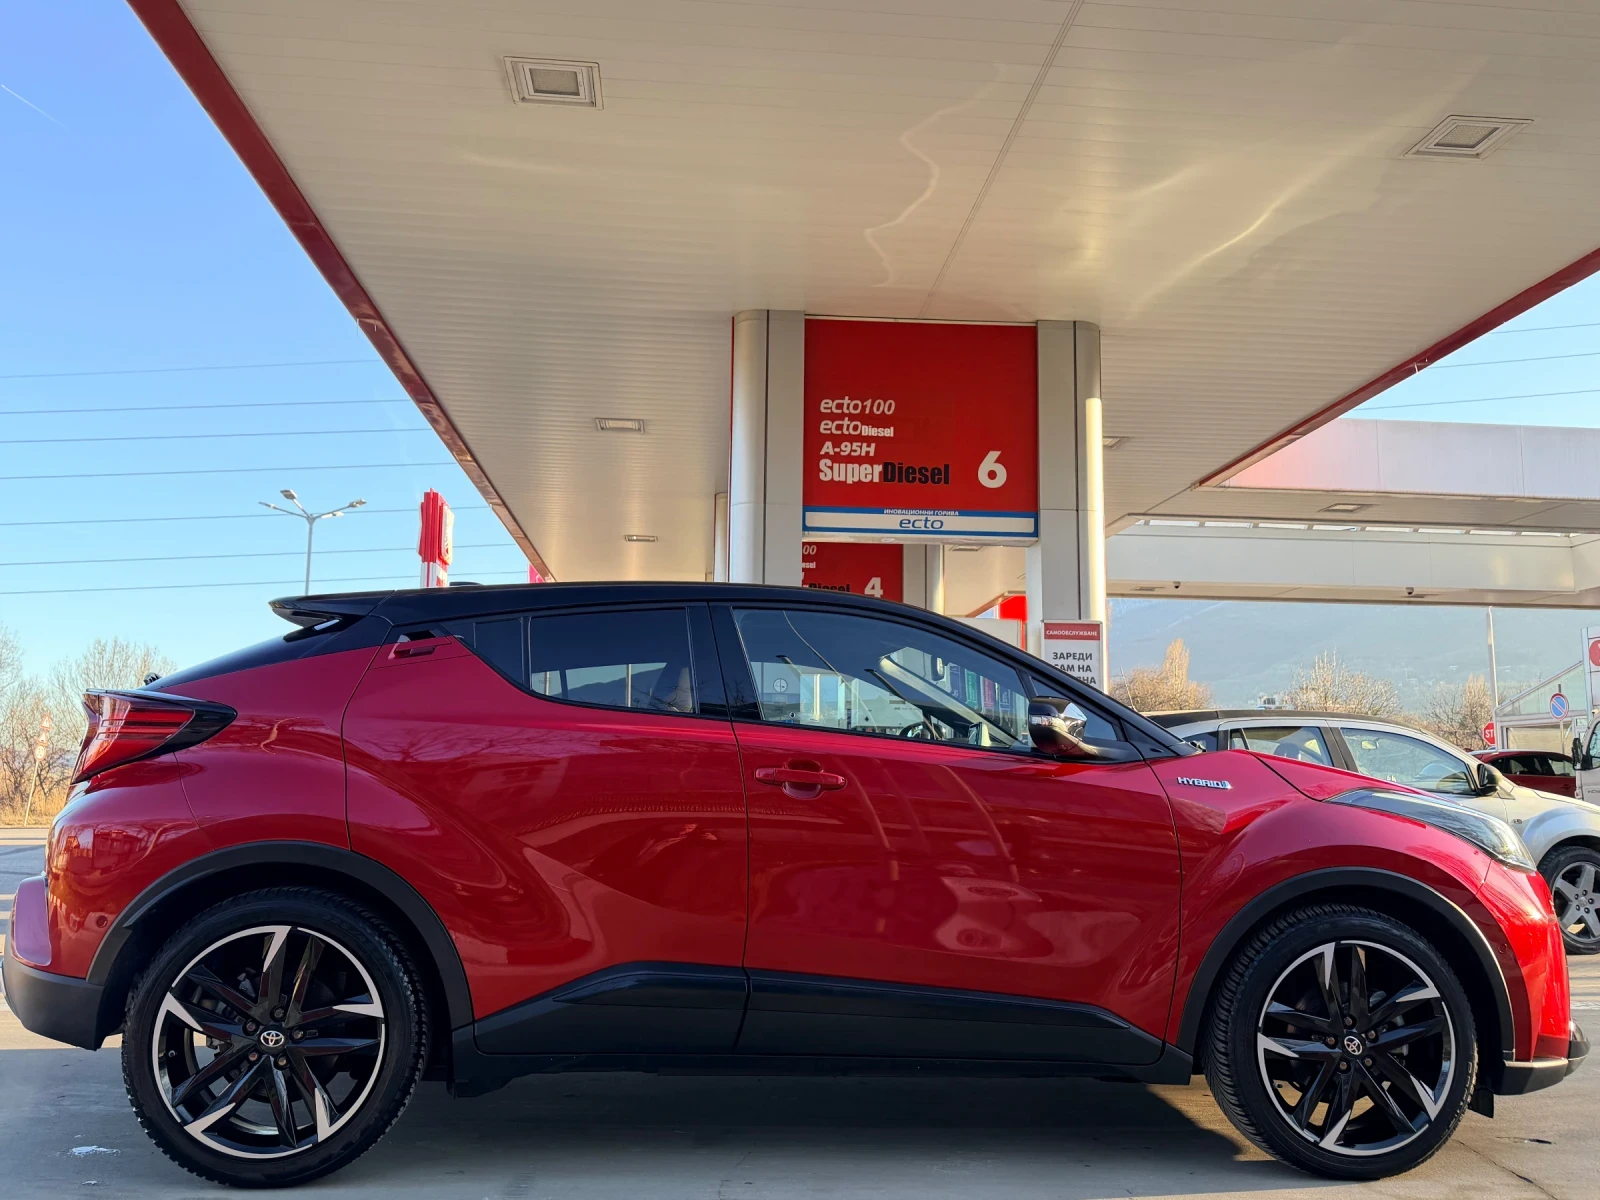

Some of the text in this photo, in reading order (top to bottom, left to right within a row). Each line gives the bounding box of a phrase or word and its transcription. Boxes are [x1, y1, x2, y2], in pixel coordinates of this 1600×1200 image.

[977, 450, 1008, 489] 6
[883, 508, 934, 516] ИНОВАЦИОННИ
[898, 516, 944, 530] ecto
[864, 576, 884, 599] 4
[1052, 651, 1093, 662] ЗАРЕДИ
[1077, 664, 1093, 673] НА
[1484, 728, 1495, 739] ST
[1177, 776, 1224, 789] HYBRID
